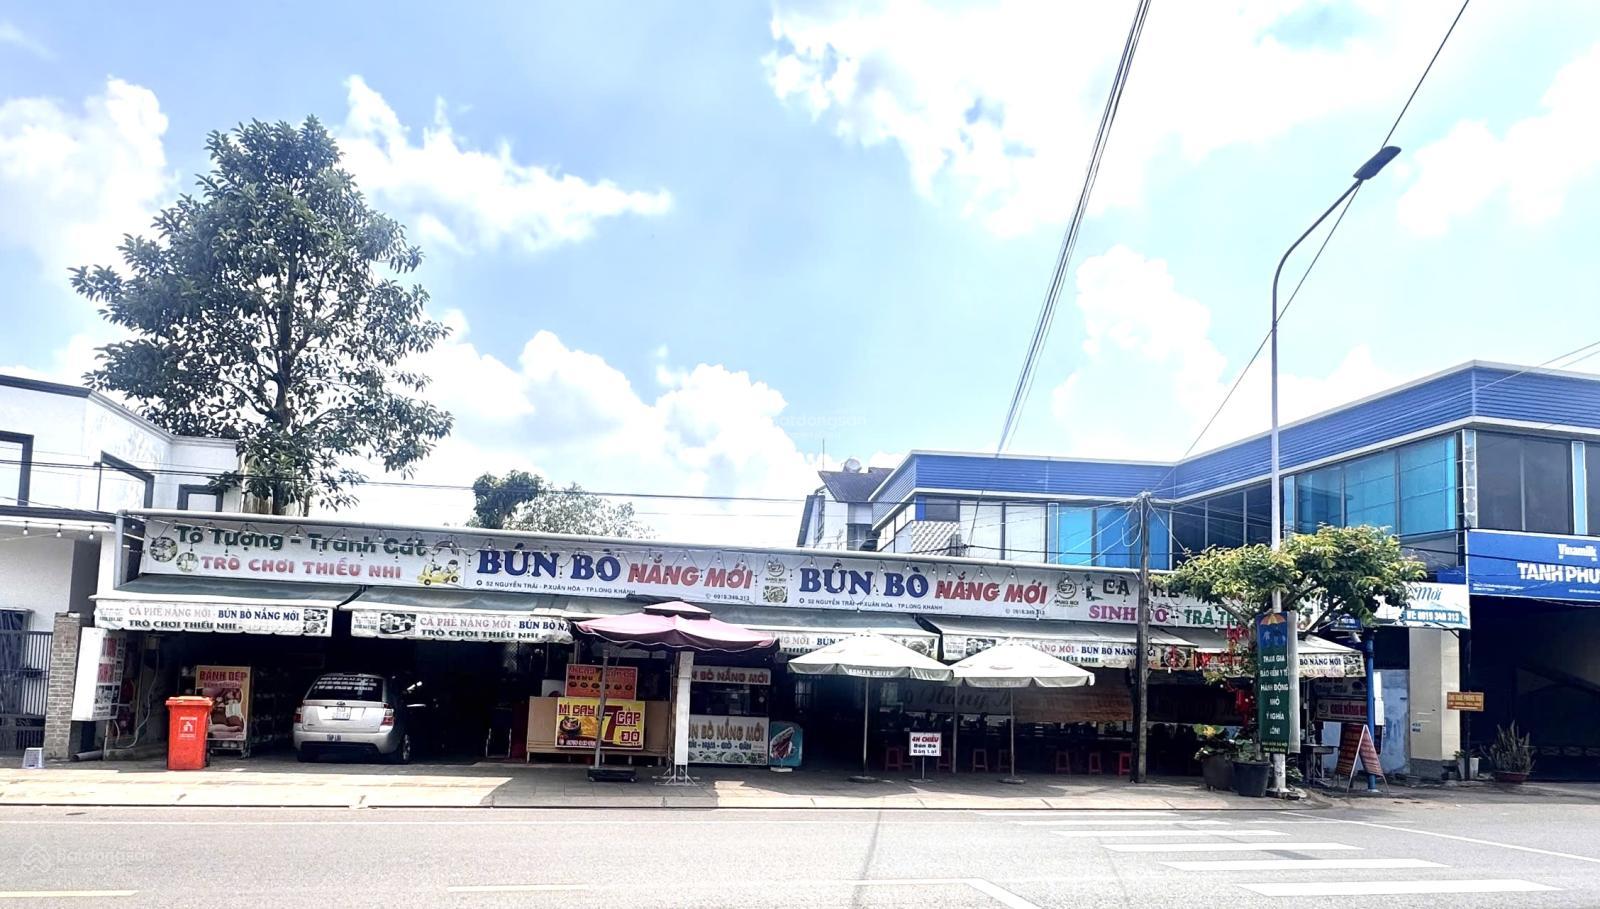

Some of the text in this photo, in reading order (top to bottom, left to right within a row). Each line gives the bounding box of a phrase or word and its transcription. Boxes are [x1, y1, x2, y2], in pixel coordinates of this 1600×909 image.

[384, 537, 427, 557] Cát
[200, 554, 402, 579] TRÒ CHƠI THIẾU NHI
[476, 542, 622, 582] BÚN BÒ
[627, 553, 754, 589] NẮNG MỚI
[1516, 562, 1564, 582] TANH
[799, 562, 929, 598] BÚN BÒ
[935, 570, 1049, 604] NẮNG MỚI
[218, 606, 300, 621] BÚN BÒ NẮNG MỚI
[1088, 604, 1137, 621] SINH
[421, 628, 445, 637] TRÒ
[518, 619, 540, 630] BÚN
[542, 619, 556, 630] BÒ
